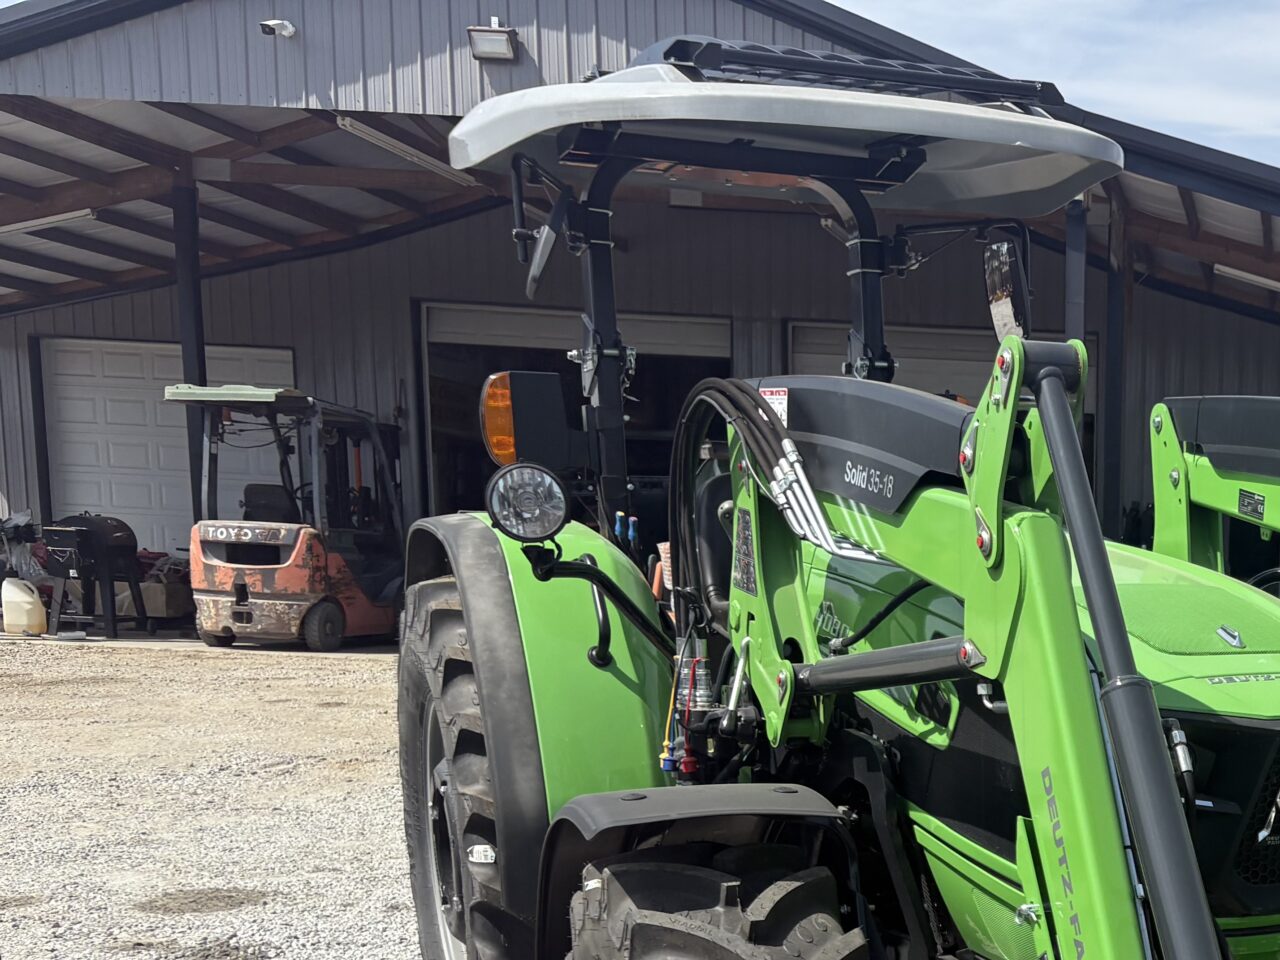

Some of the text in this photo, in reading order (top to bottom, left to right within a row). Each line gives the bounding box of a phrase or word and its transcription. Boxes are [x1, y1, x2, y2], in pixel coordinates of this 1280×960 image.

[844, 460, 894, 498] Solid 35-18
[207, 526, 287, 541] TOYO
